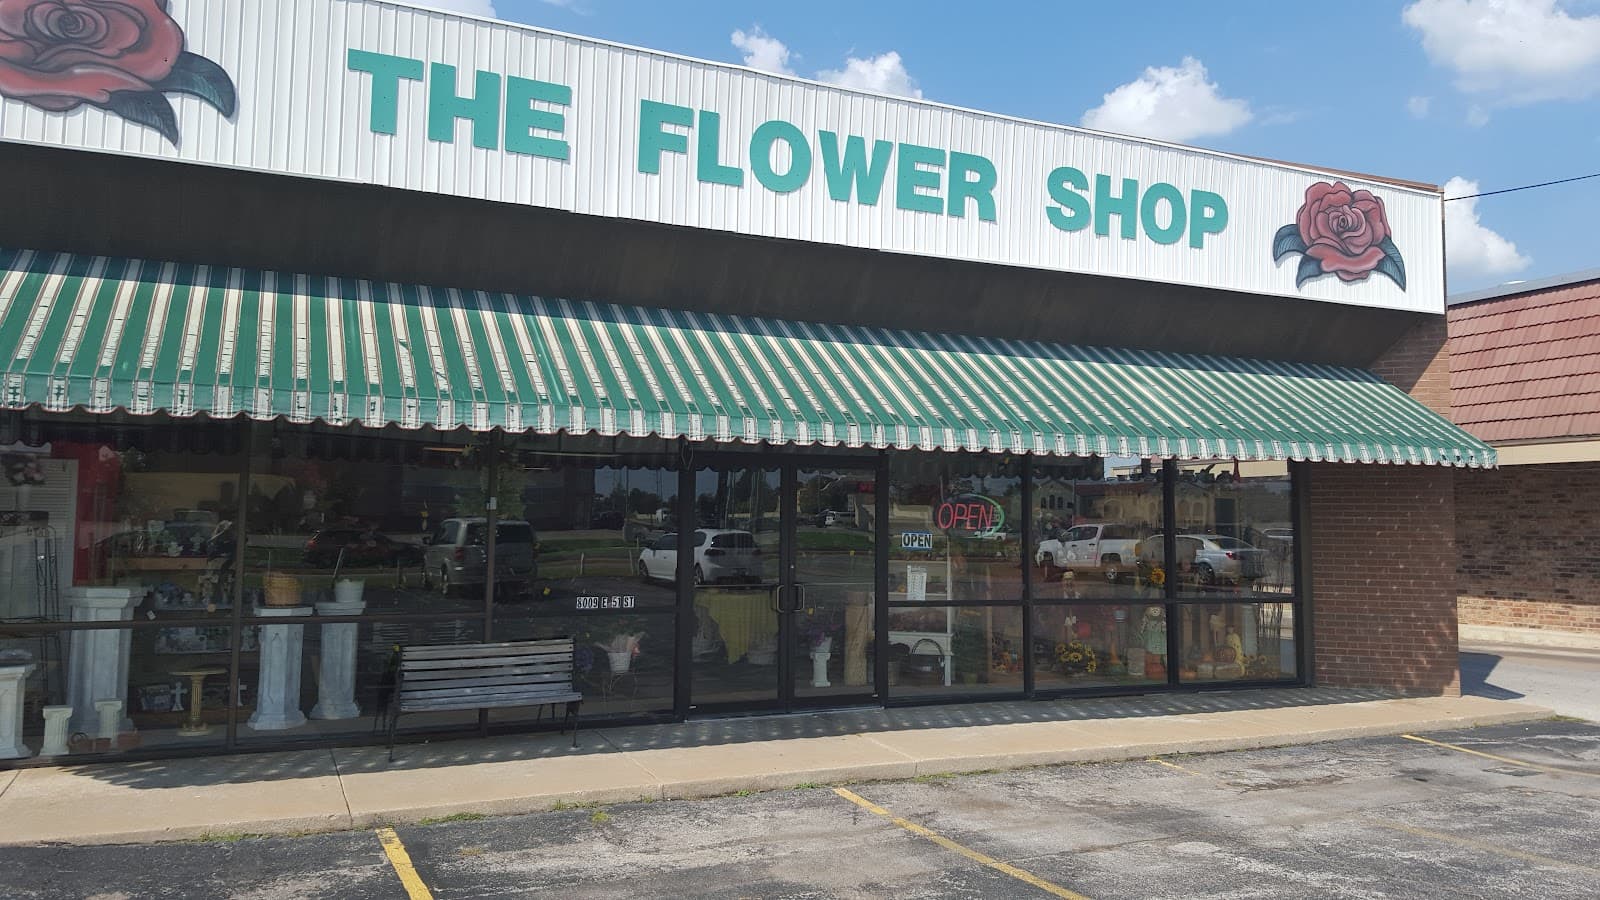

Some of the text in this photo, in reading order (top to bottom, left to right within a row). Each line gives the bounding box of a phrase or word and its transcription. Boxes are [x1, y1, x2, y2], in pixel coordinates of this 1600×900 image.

[348, 48, 1229, 249] THE FLOWER SHOP
[938, 503, 994, 530] OPEN
[902, 533, 932, 547] OPEN
[577, 596, 599, 609] 8009
[602, 597, 608, 608] E
[624, 595, 635, 608] ST
